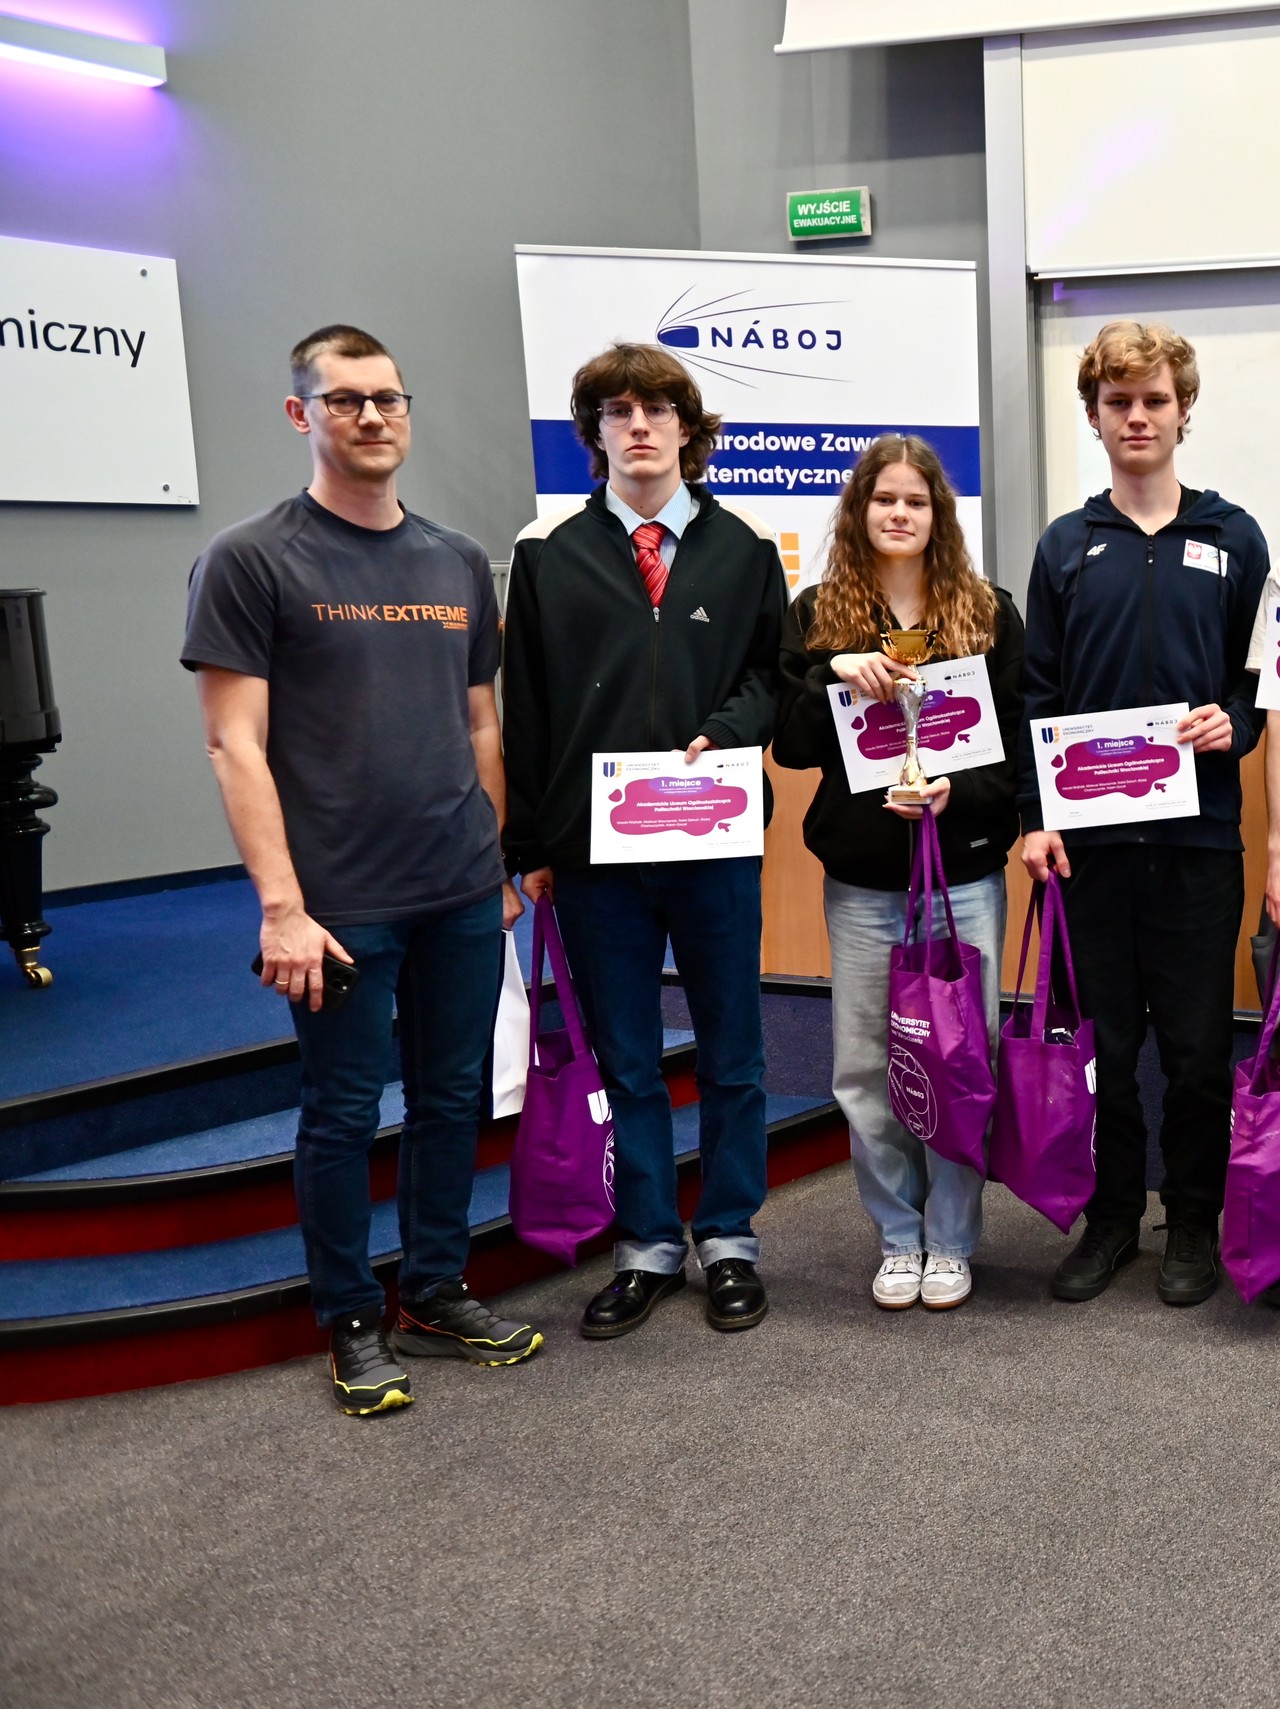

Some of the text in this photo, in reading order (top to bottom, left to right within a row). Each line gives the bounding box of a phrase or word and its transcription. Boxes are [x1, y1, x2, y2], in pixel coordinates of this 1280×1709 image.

[797, 200, 851, 216] WYJŚCIE
[793, 215, 857, 228] EWAKUACYJNE
[711, 320, 842, 351] NÁBOJ
[311, 604, 468, 622] THINK EXTREME
[1104, 739, 1134, 750] miejsce
[669, 779, 701, 788] miejsce
